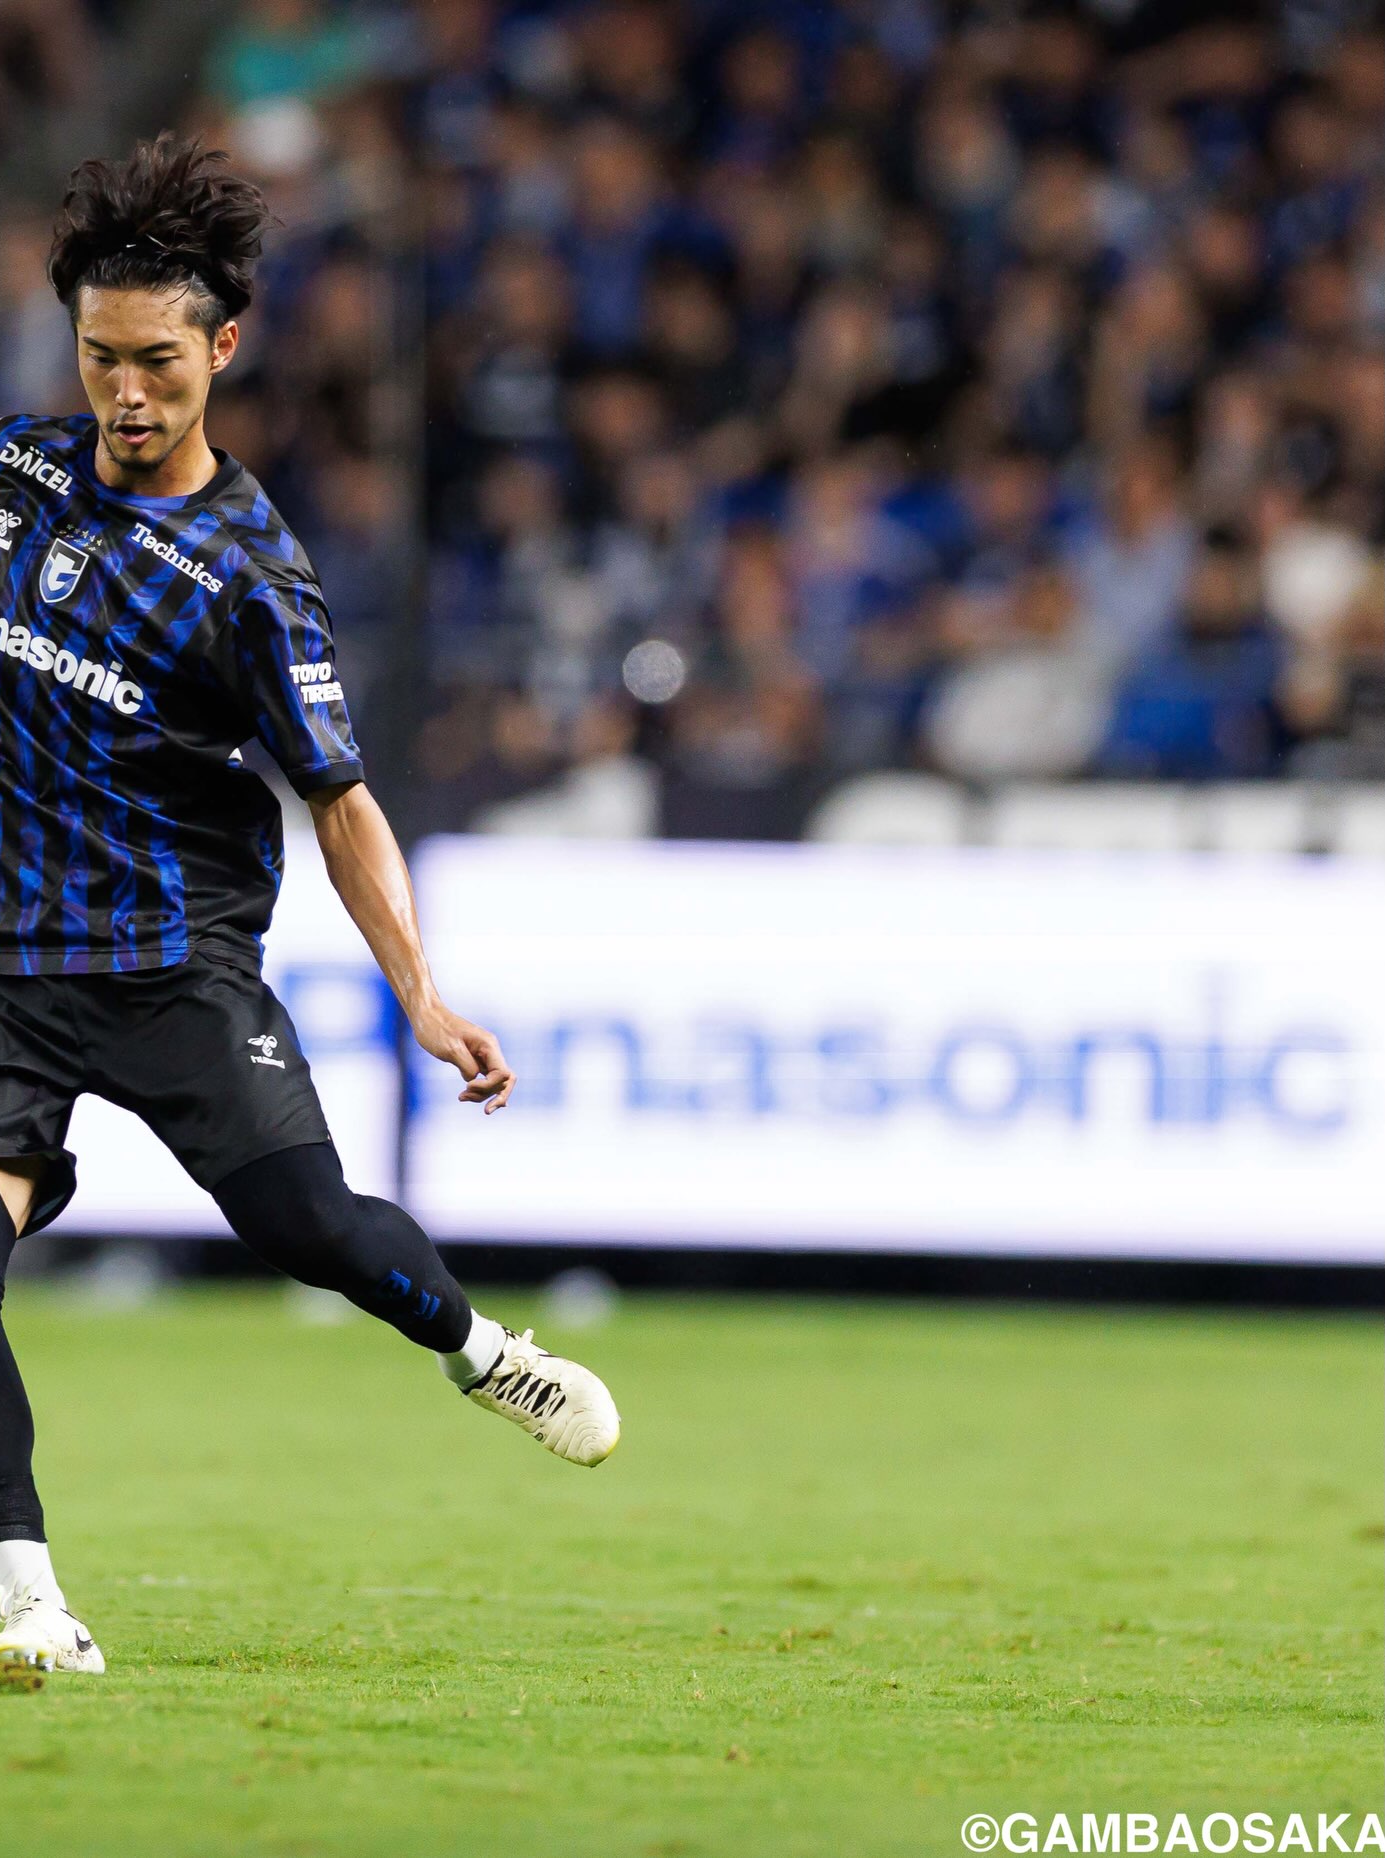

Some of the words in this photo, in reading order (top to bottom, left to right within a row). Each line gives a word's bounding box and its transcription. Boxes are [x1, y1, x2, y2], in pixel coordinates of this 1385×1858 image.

[131, 522, 224, 593] Technics
[289, 661, 332, 684] TOYO
[300, 681, 344, 704] TIRES
